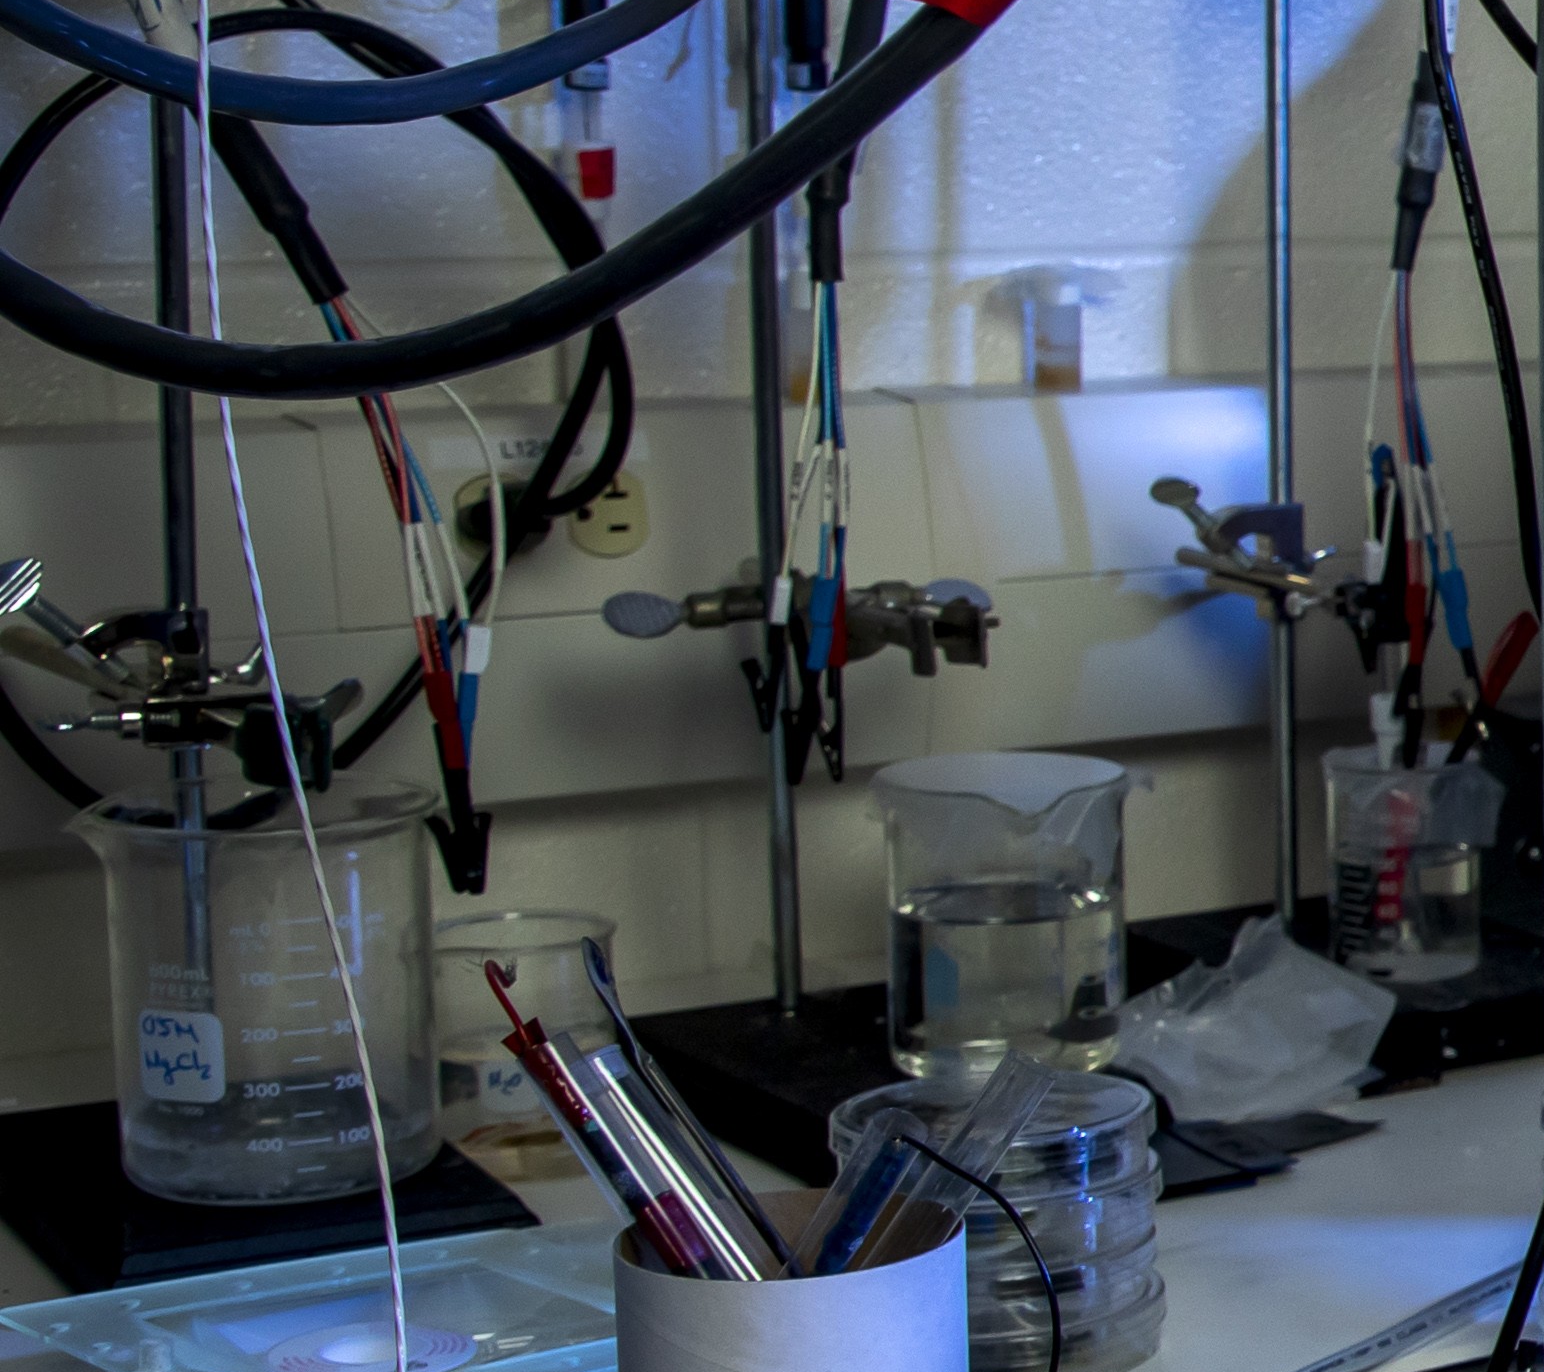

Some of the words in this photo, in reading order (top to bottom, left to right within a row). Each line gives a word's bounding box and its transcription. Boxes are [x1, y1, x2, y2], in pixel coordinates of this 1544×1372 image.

[241, 1028, 278, 1042] 200
[243, 1083, 281, 1097] 300
[248, 1137, 284, 1152] 400
